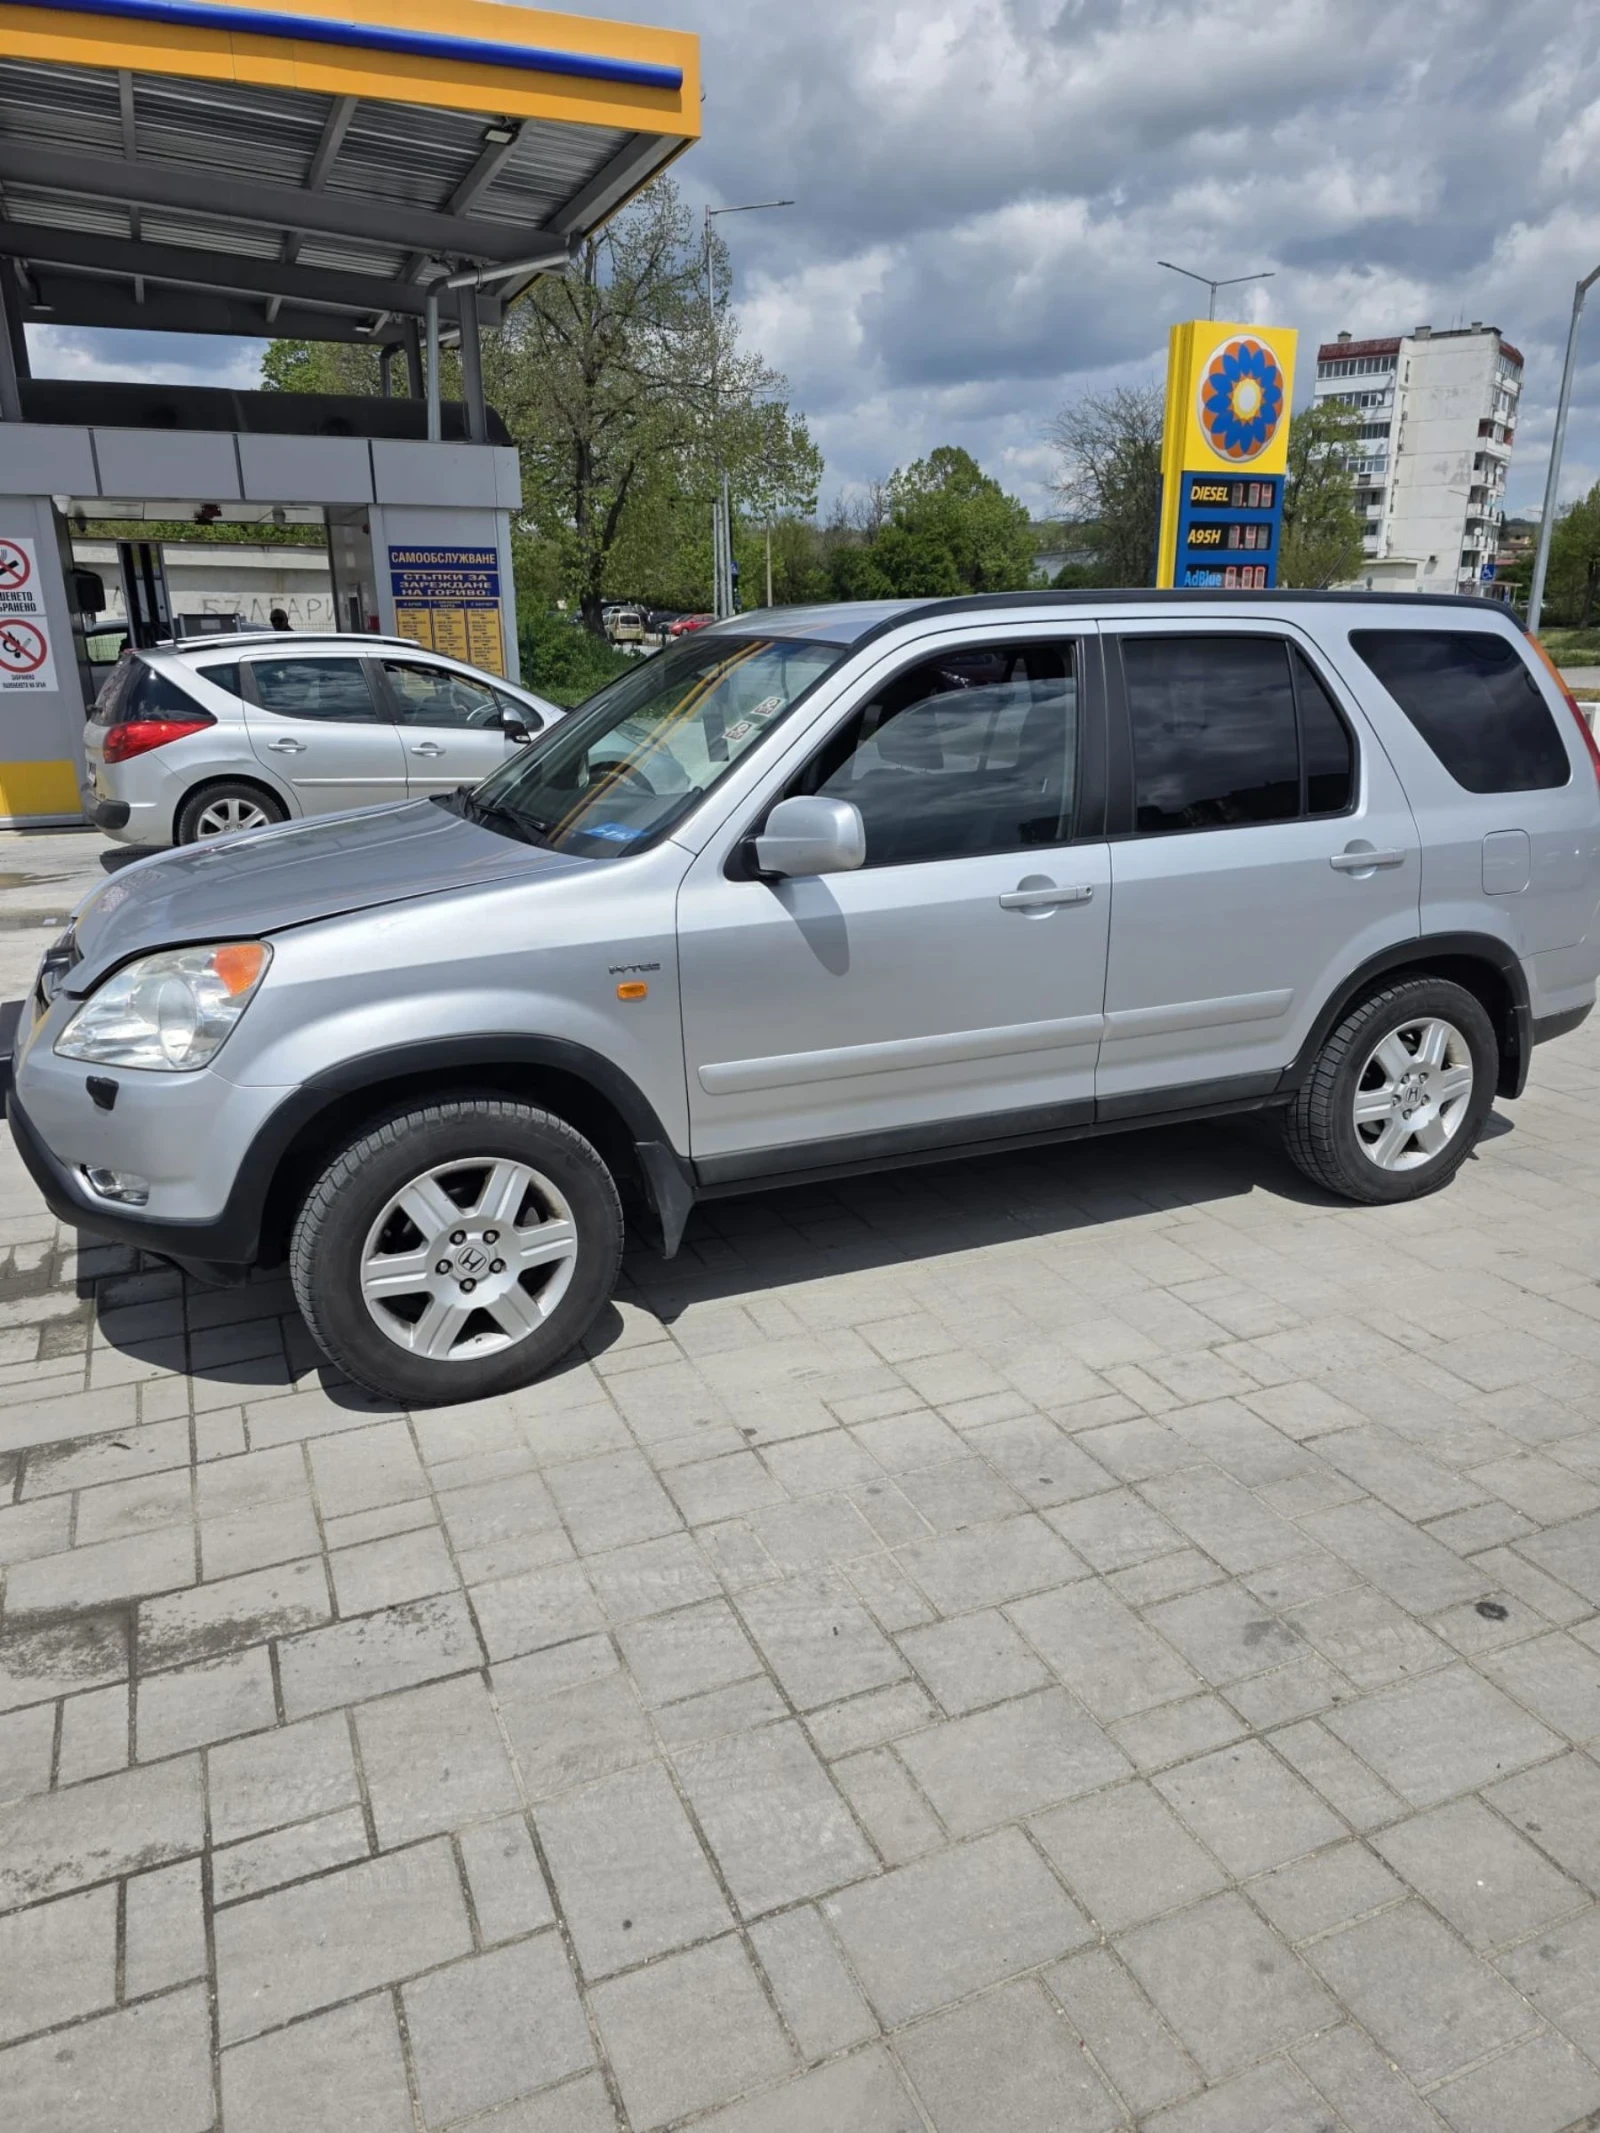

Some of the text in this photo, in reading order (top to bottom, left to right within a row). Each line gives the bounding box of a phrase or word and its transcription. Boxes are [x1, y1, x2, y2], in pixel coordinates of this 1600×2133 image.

[1190, 485, 1229, 502] DIESEL
[1187, 529, 1222, 544] A95H
[391, 552, 496, 564] САМООБСЛУЖВАНЕ
[399, 581, 492, 589] ЗАРЕЖДАНЕ
[1184, 569, 1222, 587] AdBlue
